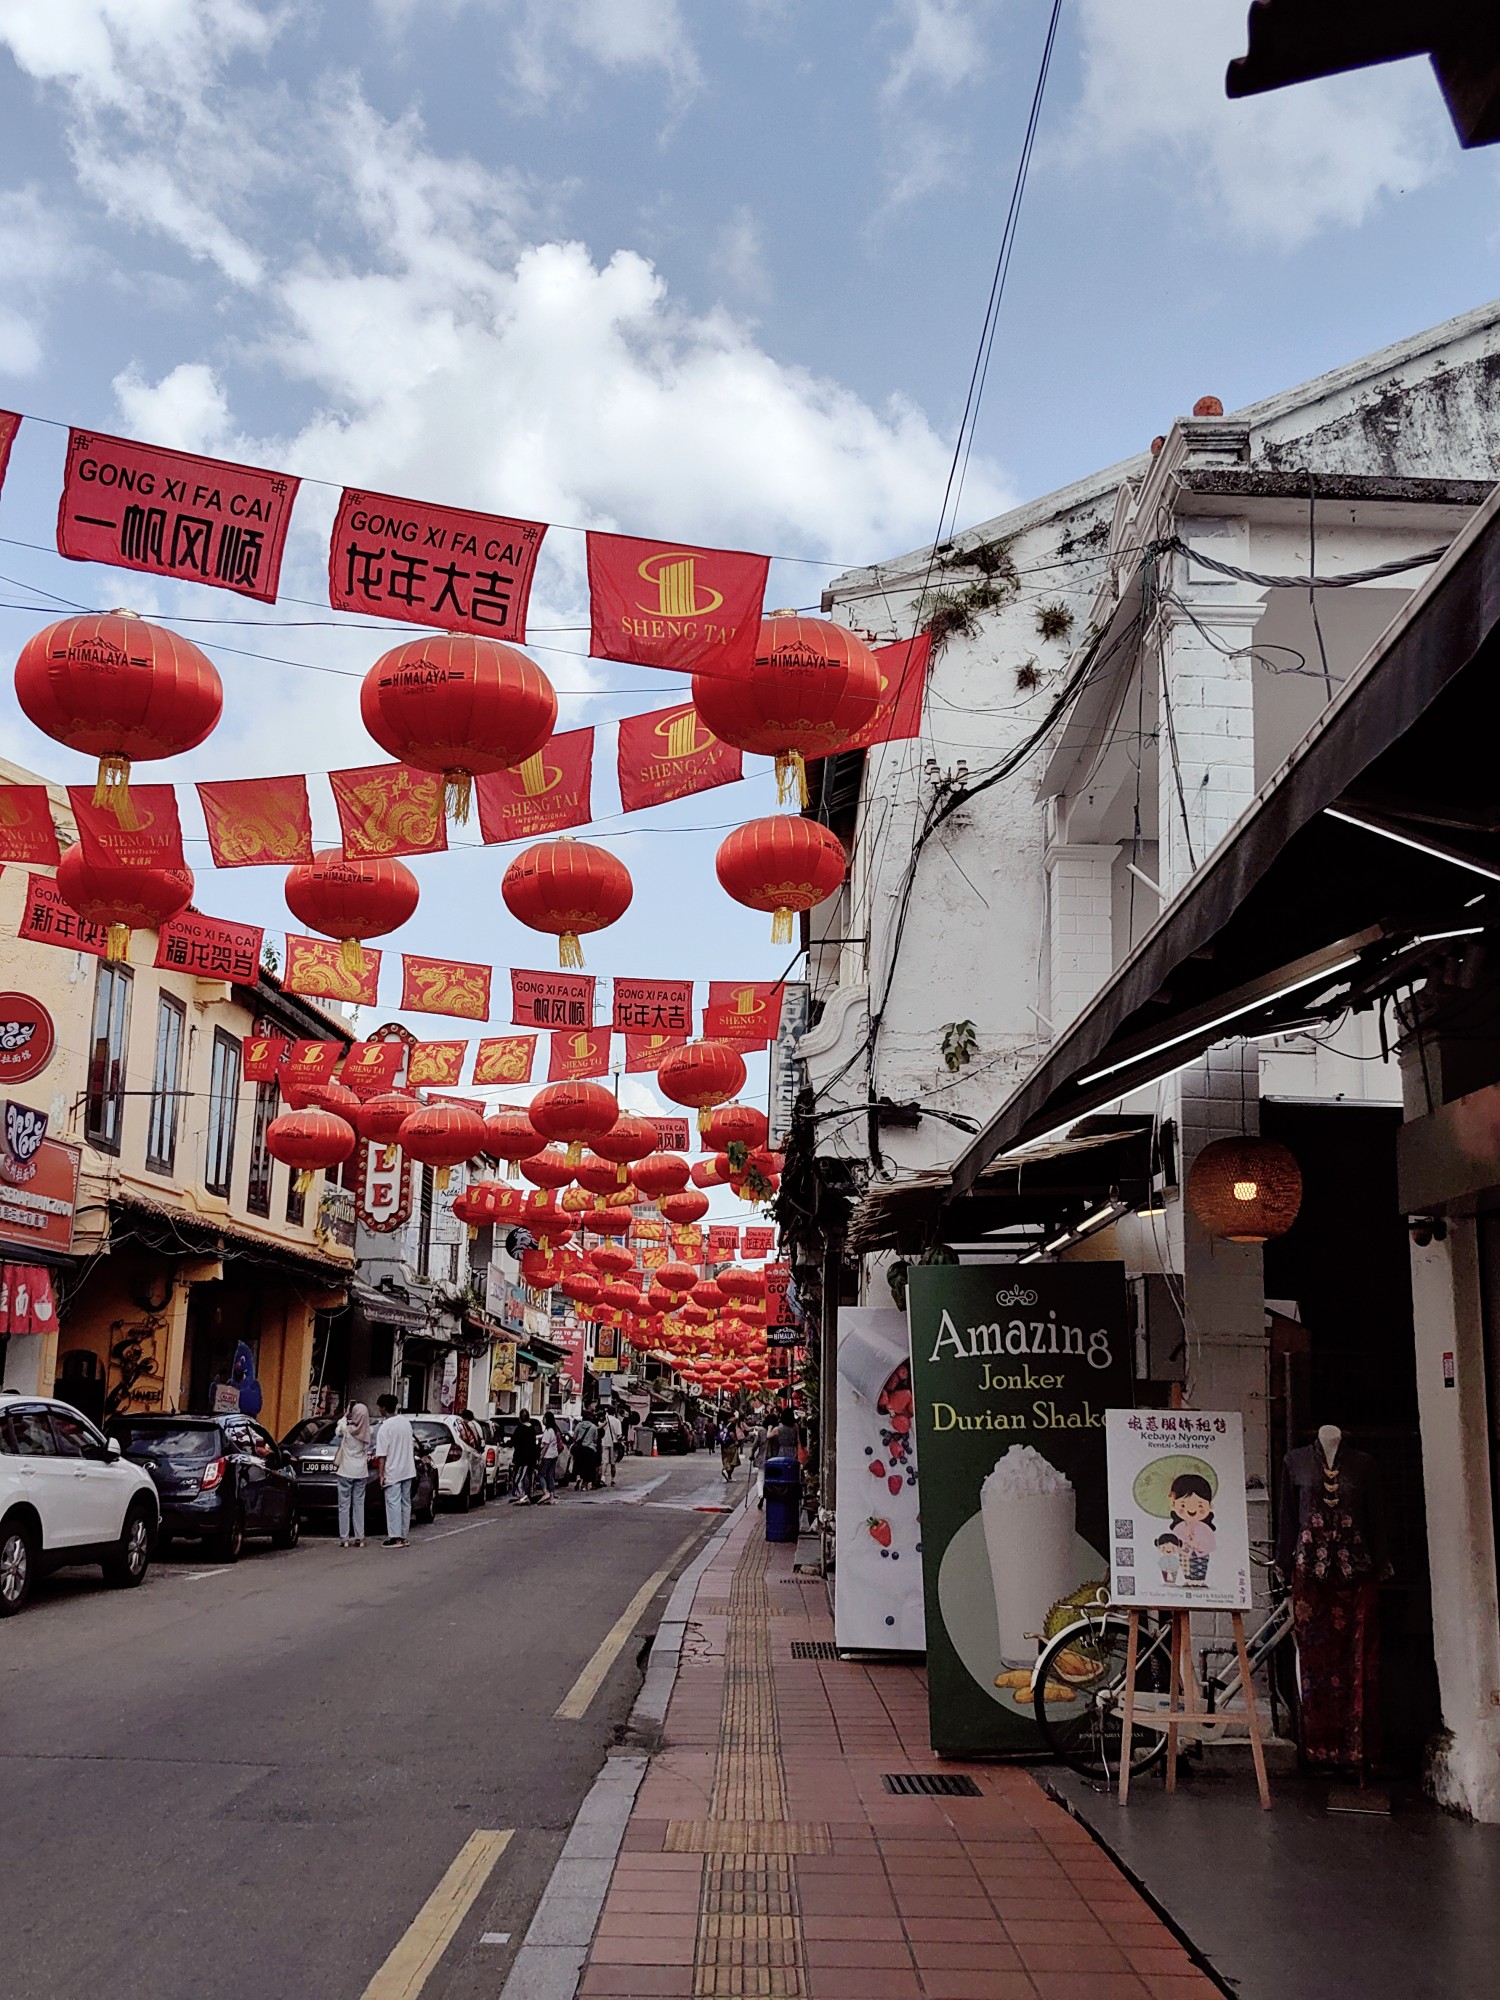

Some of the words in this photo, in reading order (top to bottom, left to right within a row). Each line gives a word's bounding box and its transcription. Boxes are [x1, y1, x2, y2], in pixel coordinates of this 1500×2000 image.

[79, 459, 156, 495] GONG
[161, 477, 187, 502] XI
[192, 485, 222, 512] FA
[229, 494, 273, 523] CAI
[74, 504, 265, 588] 一帆风顺
[350, 511, 419, 542] GONG
[422, 526, 448, 549] XI
[450, 532, 478, 557] FA
[484, 540, 524, 567] CAI
[344, 542, 514, 627] 龙年大吉
[621, 616, 698, 641] SHENG
[67, 647, 130, 668] HIMALAYA
[770, 654, 827, 670] HIMALAYA
[393, 669, 447, 687] HIMALAYA
[502, 799, 550, 819] SHENG
[552, 792, 579, 812] TAI
[98, 834, 146, 848] SHENG
[147, 834, 171, 847] TAI
[322, 871, 363, 885] HIMALAYA
[168, 919, 201, 937] GONG
[205, 927, 216, 939] XI
[218, 930, 233, 943] FA
[235, 935, 256, 948] CAI
[516, 981, 545, 994] GONG
[546, 984, 556, 996] XI
[557, 985, 569, 997] FA
[570, 987, 587, 999] CAI
[618, 988, 645, 1000] GONG
[646, 990, 655, 1002] XI
[656, 991, 669, 1002] FA
[670, 991, 686, 1003] CAI
[518, 997, 585, 1026] 一帆风顺
[617, 1003, 686, 1029] 龙年大吉
[719, 1015, 755, 1025] SHENG
[349, 1066, 372, 1074] SHENG
[373, 1067, 385, 1075] TAI
[561, 1061, 588, 1070] SHENG
[356, 1086, 378, 1096] GONG
[776, 1314, 796, 1324] CAI
[773, 1333, 799, 1341] HIMALAYA
[928, 1308, 1113, 1369] Amazing
[978, 1363, 1065, 1390] Jonker
[932, 1402, 1027, 1432] Durian
[1141, 1432, 1176, 1443] Kebaya
[1178, 1433, 1216, 1444] Nyonya
